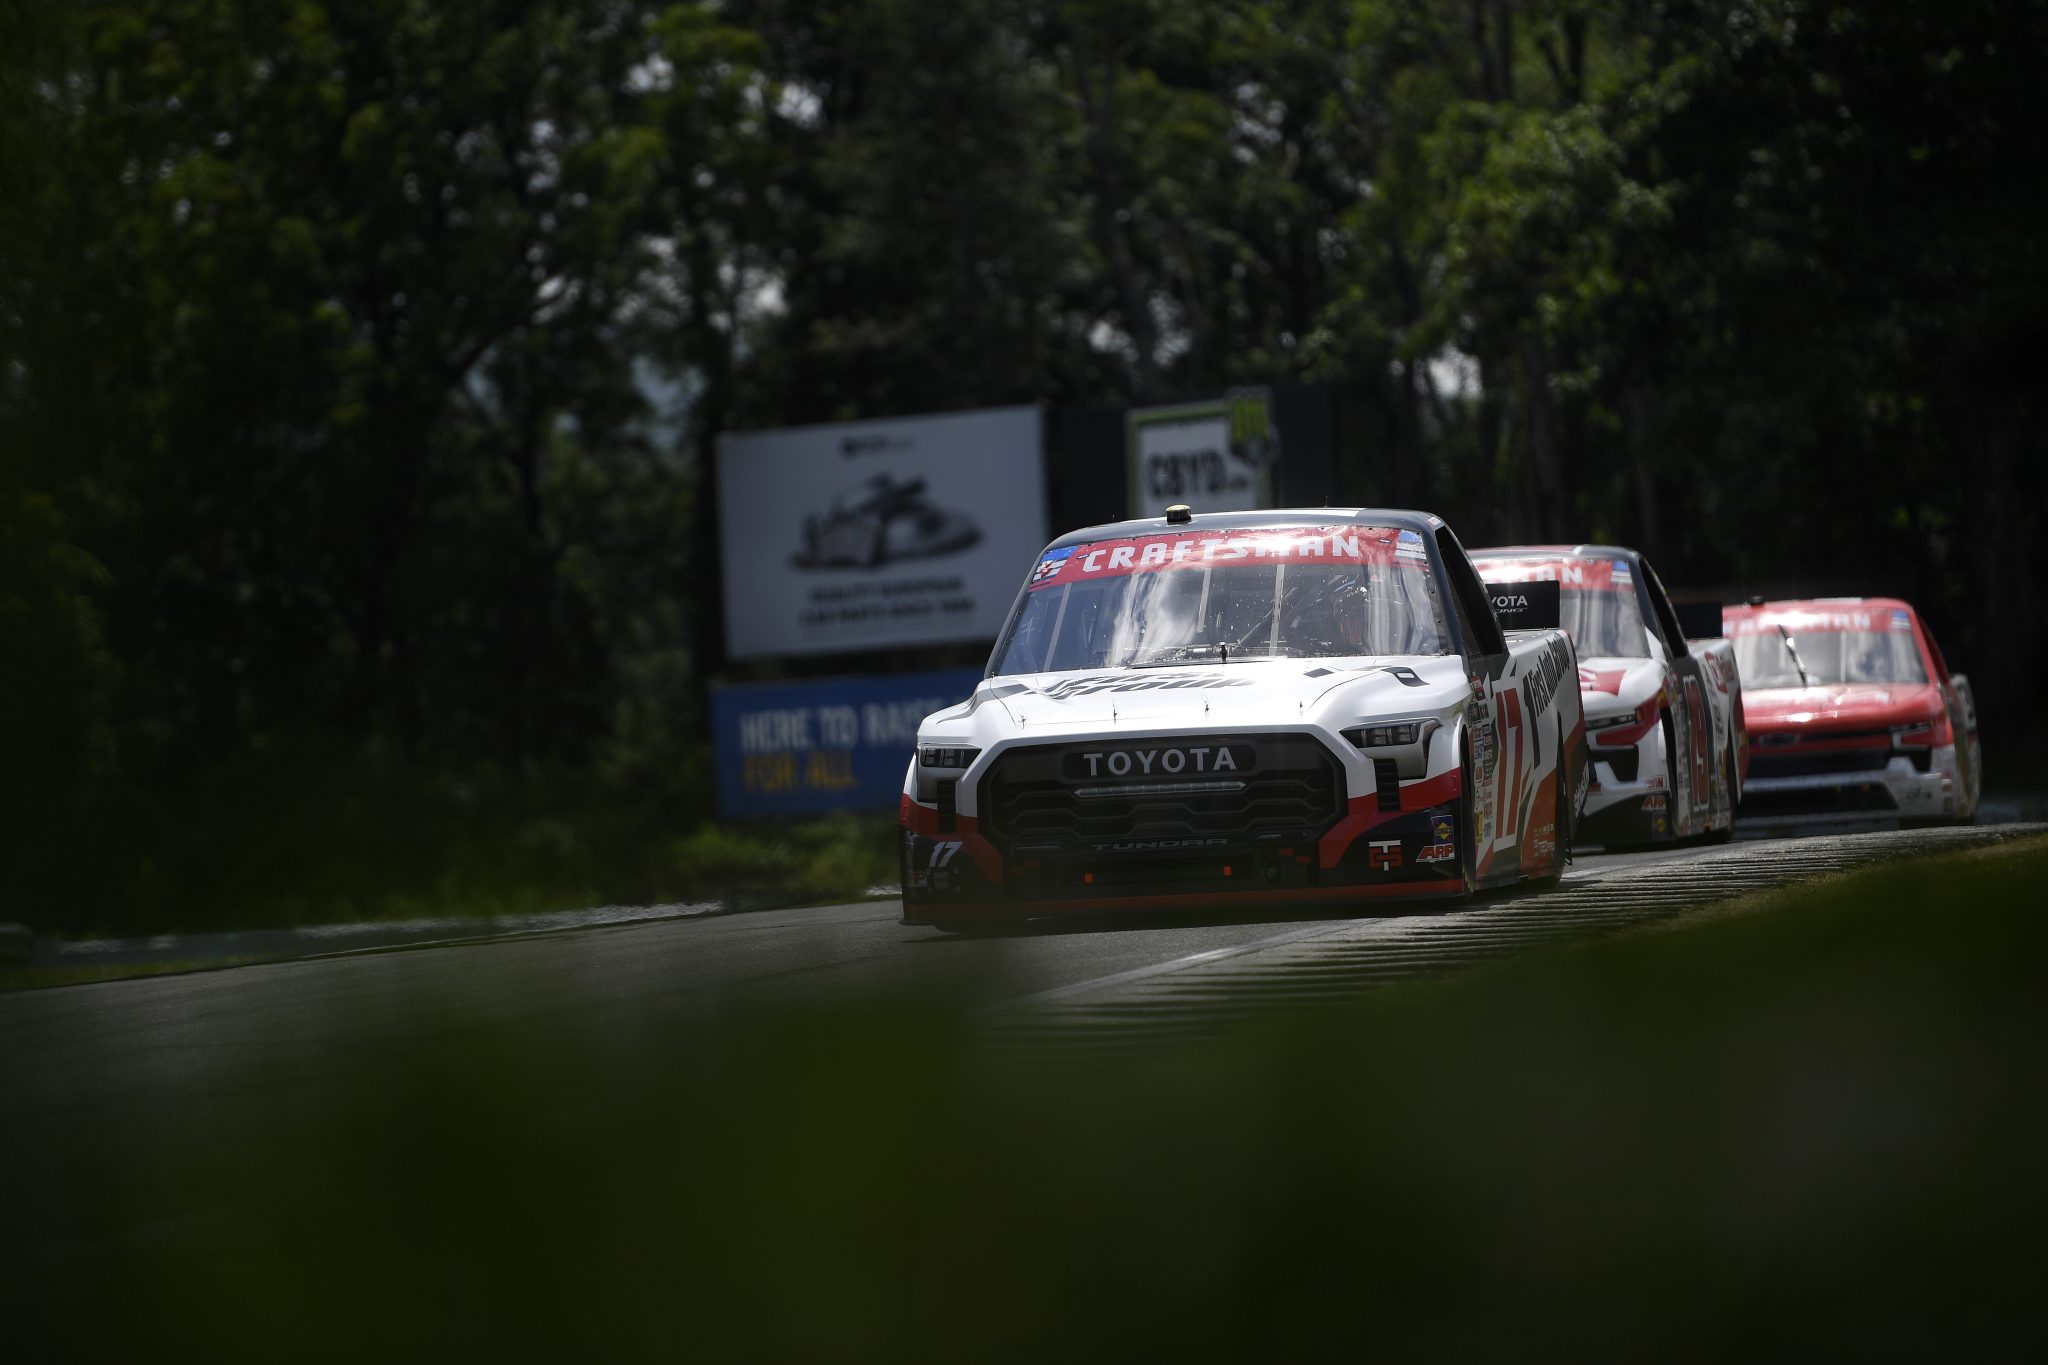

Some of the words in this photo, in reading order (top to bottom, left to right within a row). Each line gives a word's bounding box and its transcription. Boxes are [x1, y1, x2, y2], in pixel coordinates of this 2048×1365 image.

[1081, 535, 1359, 573] CRAFTSMAN
[738, 708, 814, 753] HERE
[818, 704, 860, 749] TO
[1083, 746, 1238, 777] TOYOTA
[928, 841, 964, 868] 17
[1091, 838, 1229, 851] TUNDRA
[1417, 844, 1456, 863] ARP
